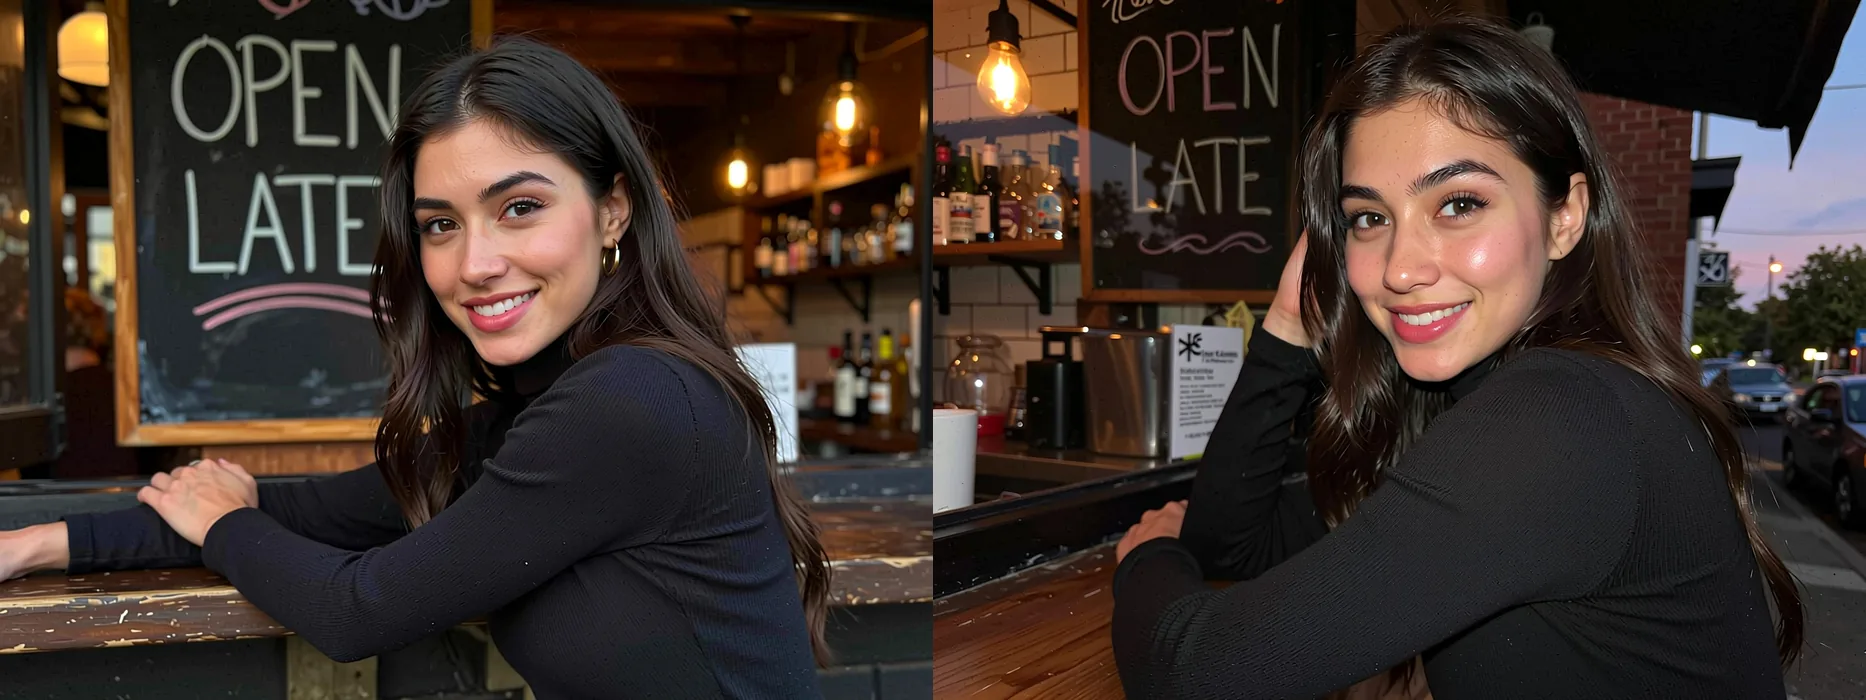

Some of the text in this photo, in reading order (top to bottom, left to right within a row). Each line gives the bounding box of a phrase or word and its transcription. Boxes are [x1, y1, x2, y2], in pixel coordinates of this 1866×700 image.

[171, 35, 401, 149] OPEN
[1118, 23, 1281, 116] OPEN
[185, 169, 384, 276] LATE
[1130, 136, 1272, 216] LATE
